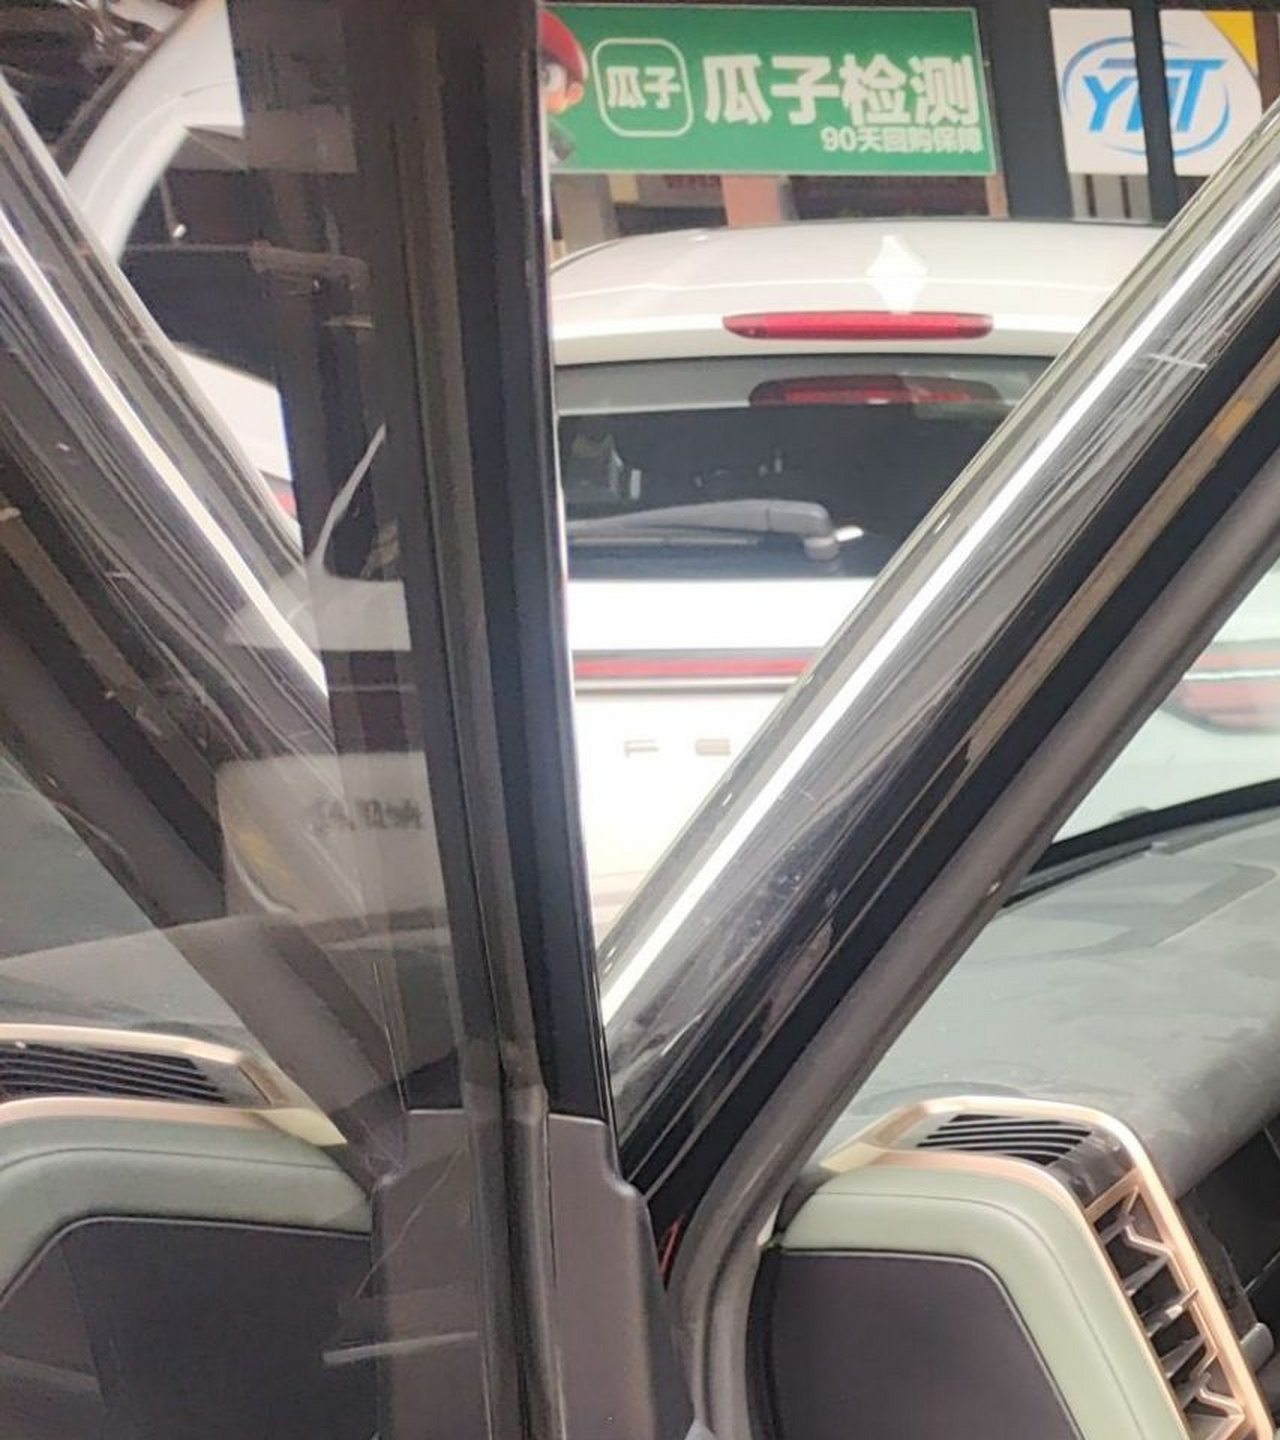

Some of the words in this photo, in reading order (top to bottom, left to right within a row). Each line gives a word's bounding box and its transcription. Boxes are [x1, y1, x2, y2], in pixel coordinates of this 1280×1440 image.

[606, 66, 682, 109] 瓜子
[702, 54, 980, 126] 瓜子检测
